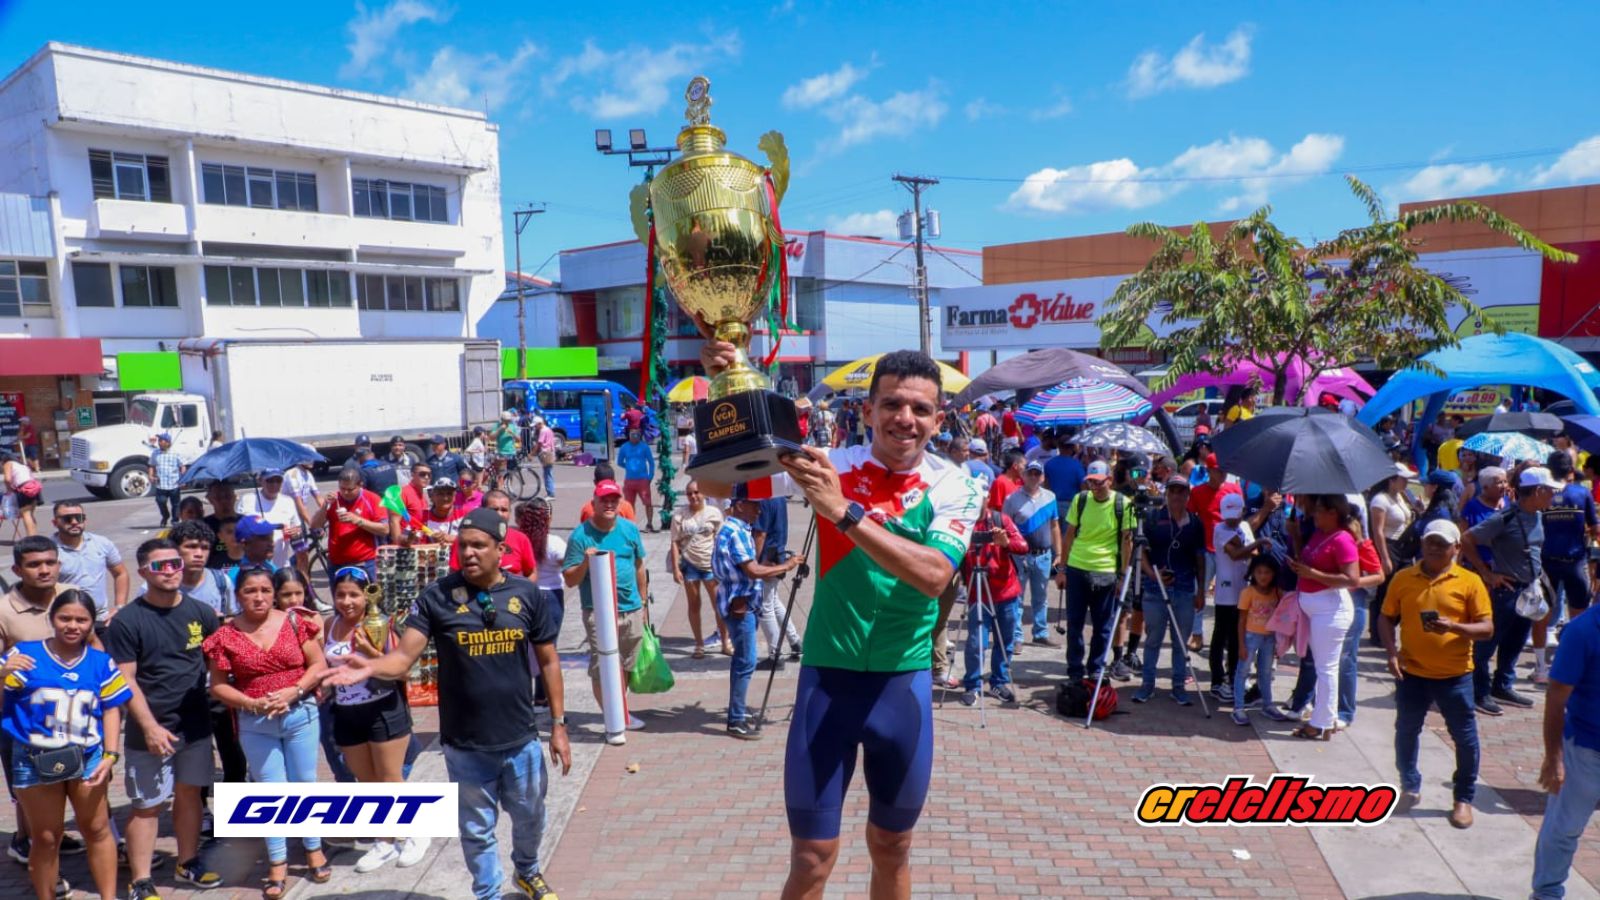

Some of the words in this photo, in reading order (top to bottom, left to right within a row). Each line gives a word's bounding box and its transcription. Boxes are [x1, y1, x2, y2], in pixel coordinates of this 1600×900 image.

[946, 305, 1008, 326] Farma
[1041, 293, 1095, 321] Value
[708, 421, 746, 440] CAMPEÓN
[457, 628, 524, 645] Emirates
[470, 644, 484, 656] FLY
[486, 641, 516, 655] BETTER
